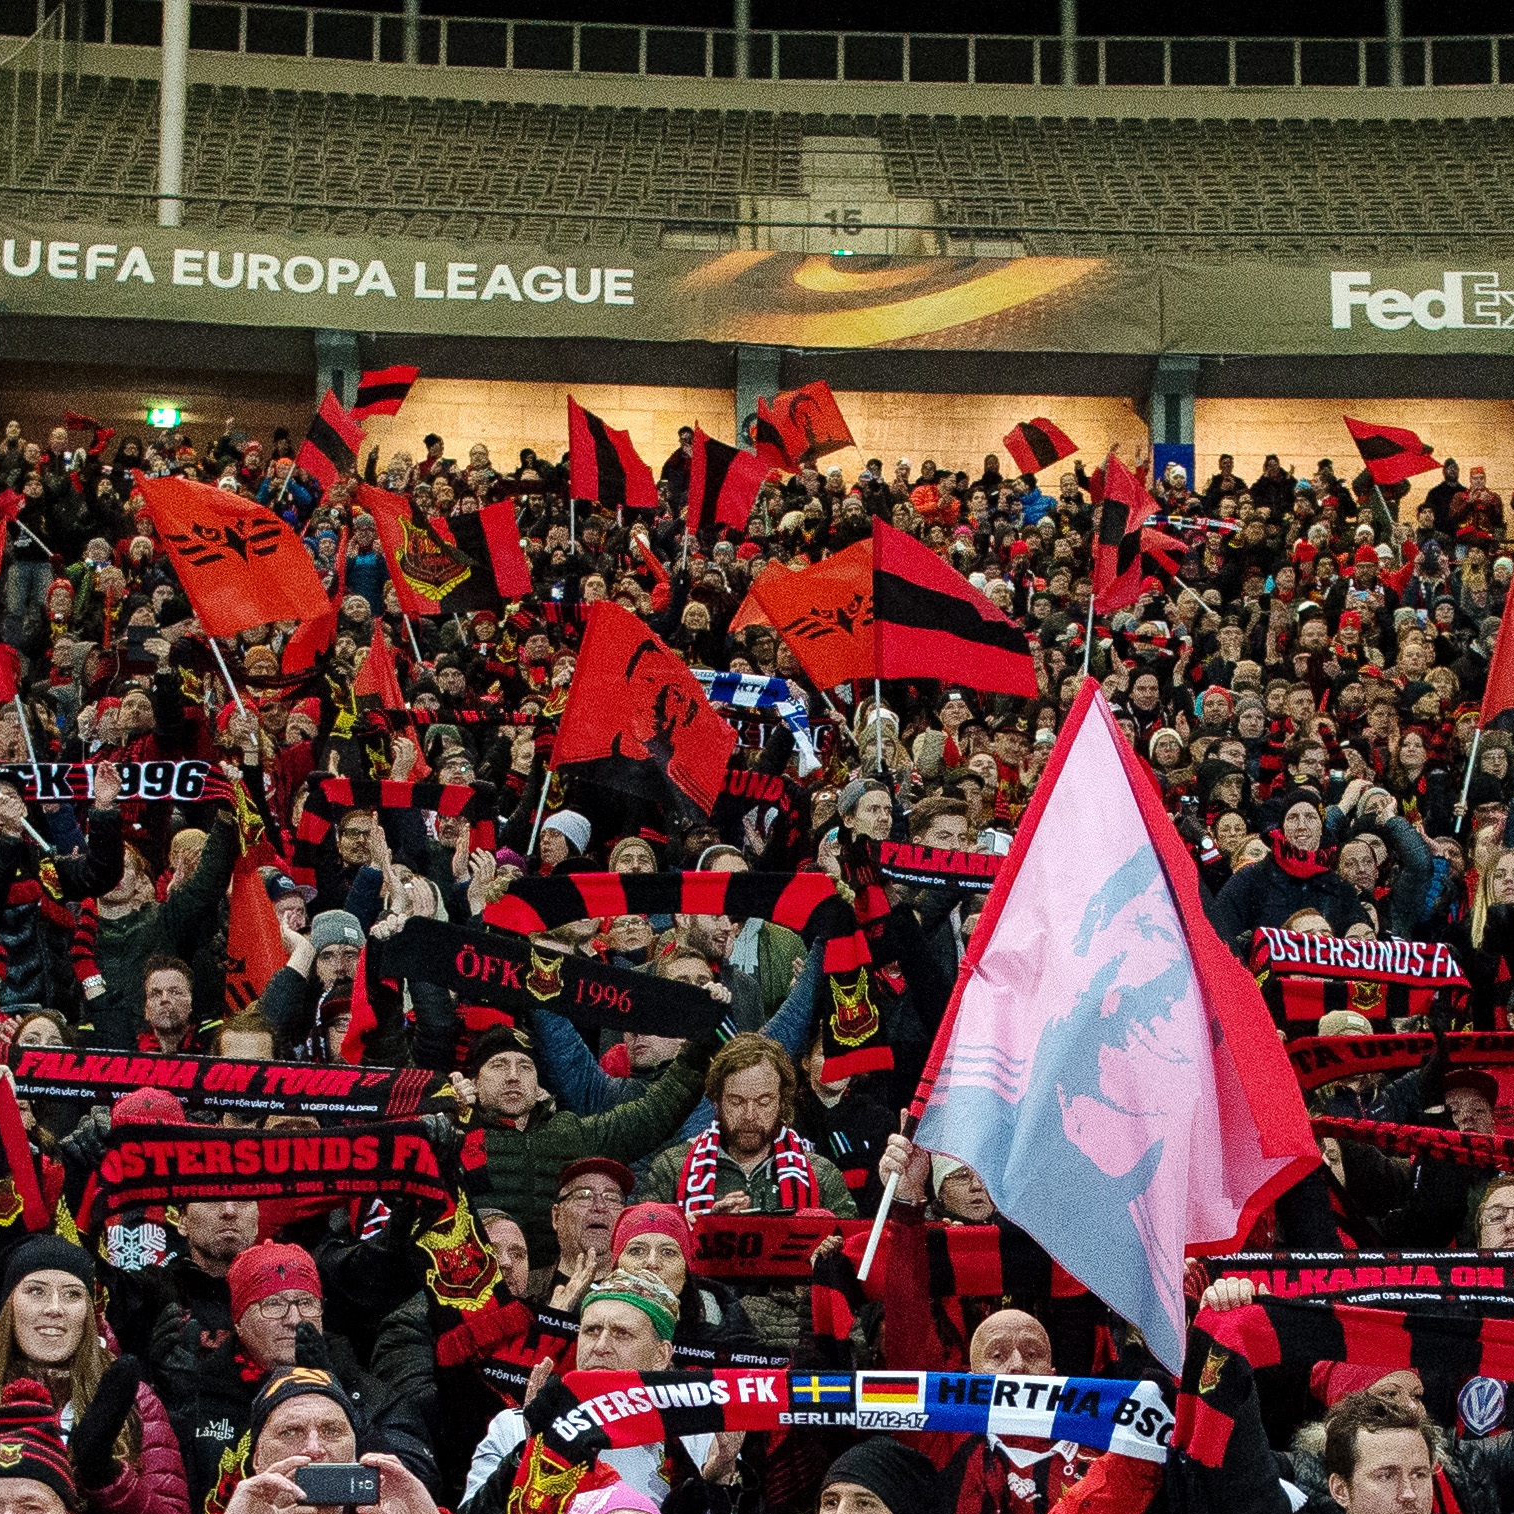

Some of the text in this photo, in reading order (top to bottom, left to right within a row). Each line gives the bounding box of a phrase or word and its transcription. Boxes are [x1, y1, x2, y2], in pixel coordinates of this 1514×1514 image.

[824, 209, 863, 236] 15
[2, 239, 637, 306] UEFA EUROPA LEAGUE
[455, 944, 633, 1014] ÖFK 1996
[15, 1050, 362, 1097] FALKARNA ON TOUR
[1449, 1265, 1506, 1289] ON
[537, 1313, 561, 1329] FOLA
[730, 1352, 768, 1366] HERTHA
[552, 1374, 779, 1443] ÖSTERSUNDS FK
[937, 1376, 1103, 1418] HERTHA
[778, 1411, 930, 1430] BERLIN 7/12-17
